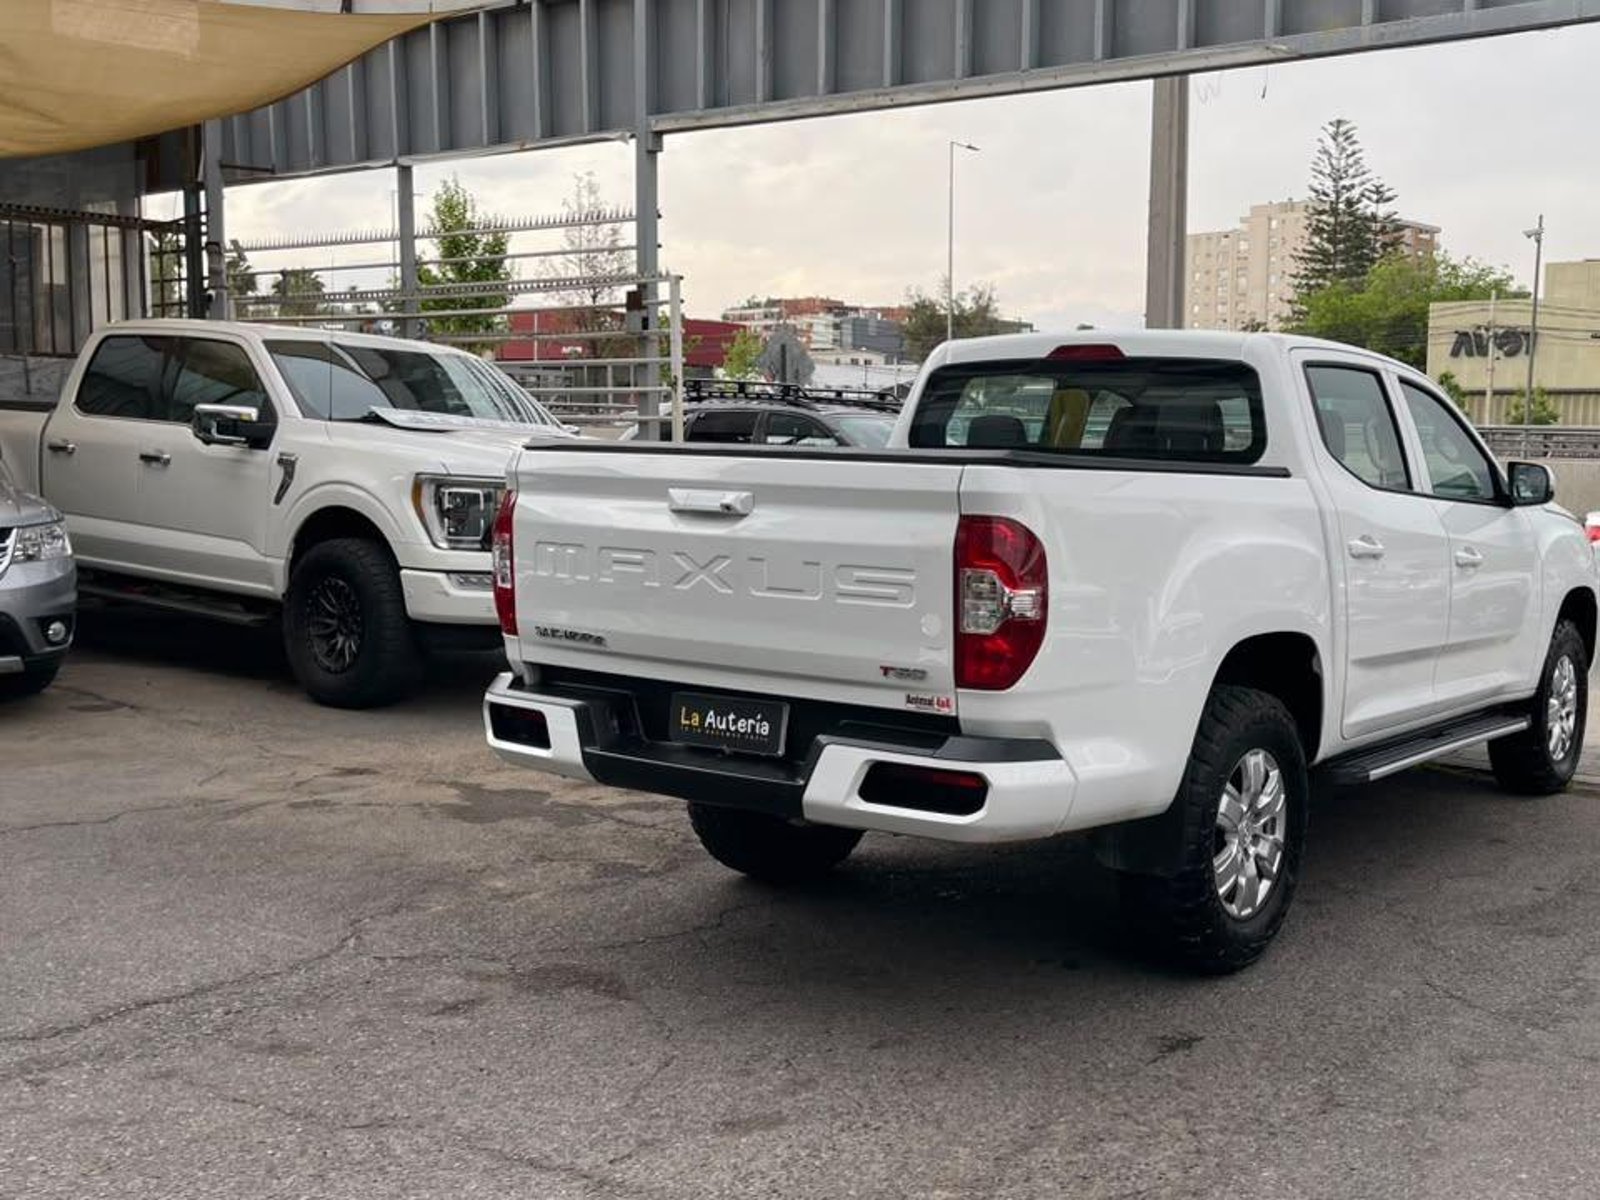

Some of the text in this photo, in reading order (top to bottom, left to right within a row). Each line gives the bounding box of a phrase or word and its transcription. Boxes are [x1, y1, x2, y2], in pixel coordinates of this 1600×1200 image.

[534, 540, 917, 609] MAXUS
[680, 706, 699, 726] La
[704, 709, 770, 736] Autería
